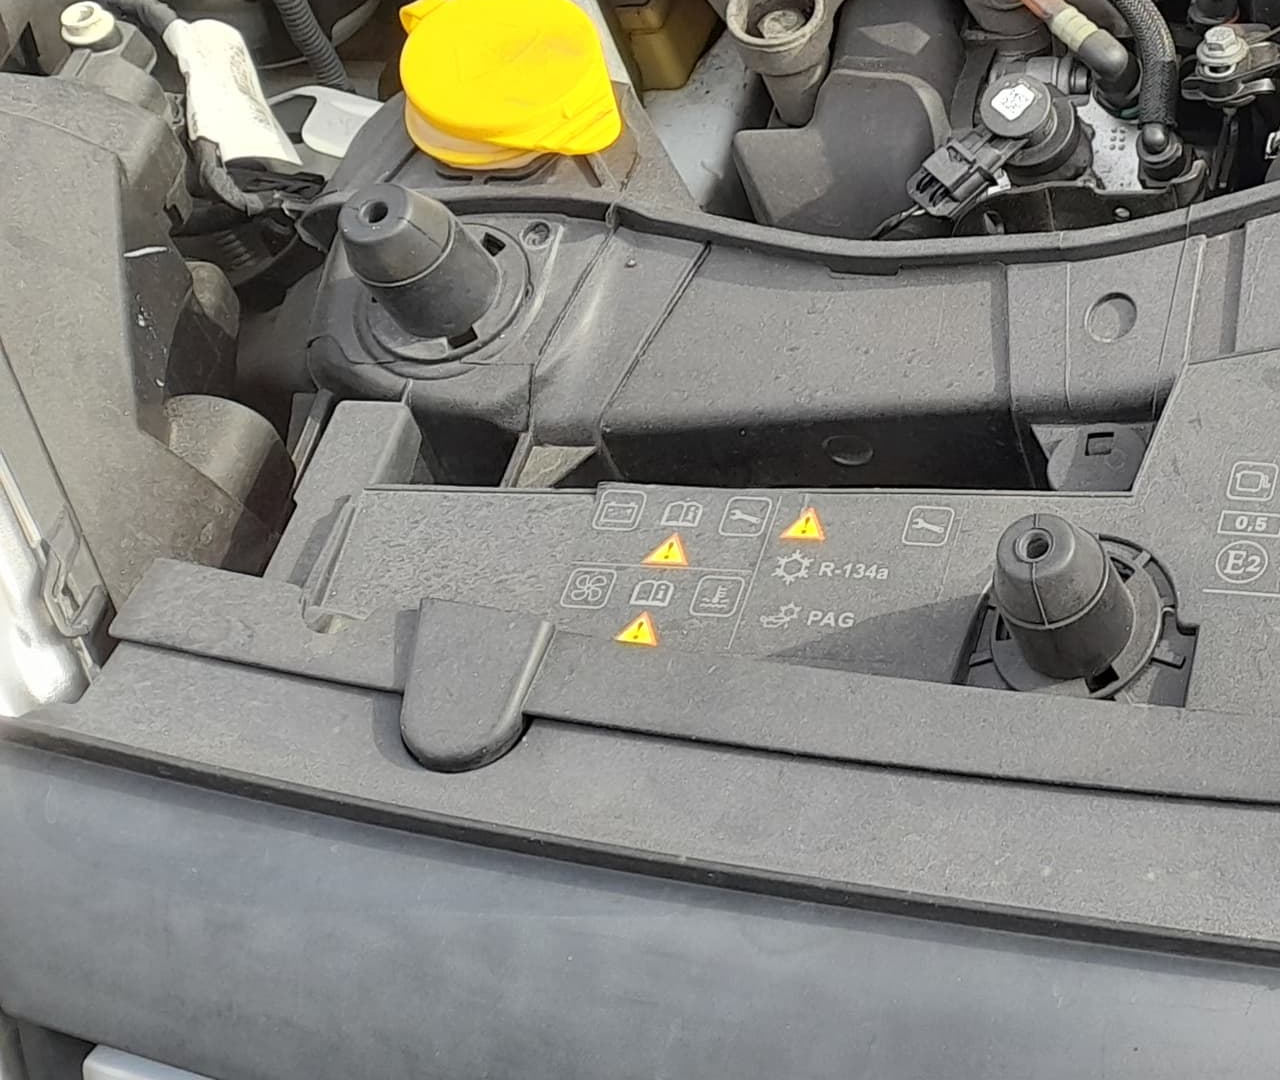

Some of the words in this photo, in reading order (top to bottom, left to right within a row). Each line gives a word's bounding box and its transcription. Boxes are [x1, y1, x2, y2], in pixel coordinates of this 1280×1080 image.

[1235, 516, 1268, 532] 0,5
[818, 562, 889, 580] R-134a
[1223, 550, 1262, 575] E2
[807, 610, 855, 628] PAG
